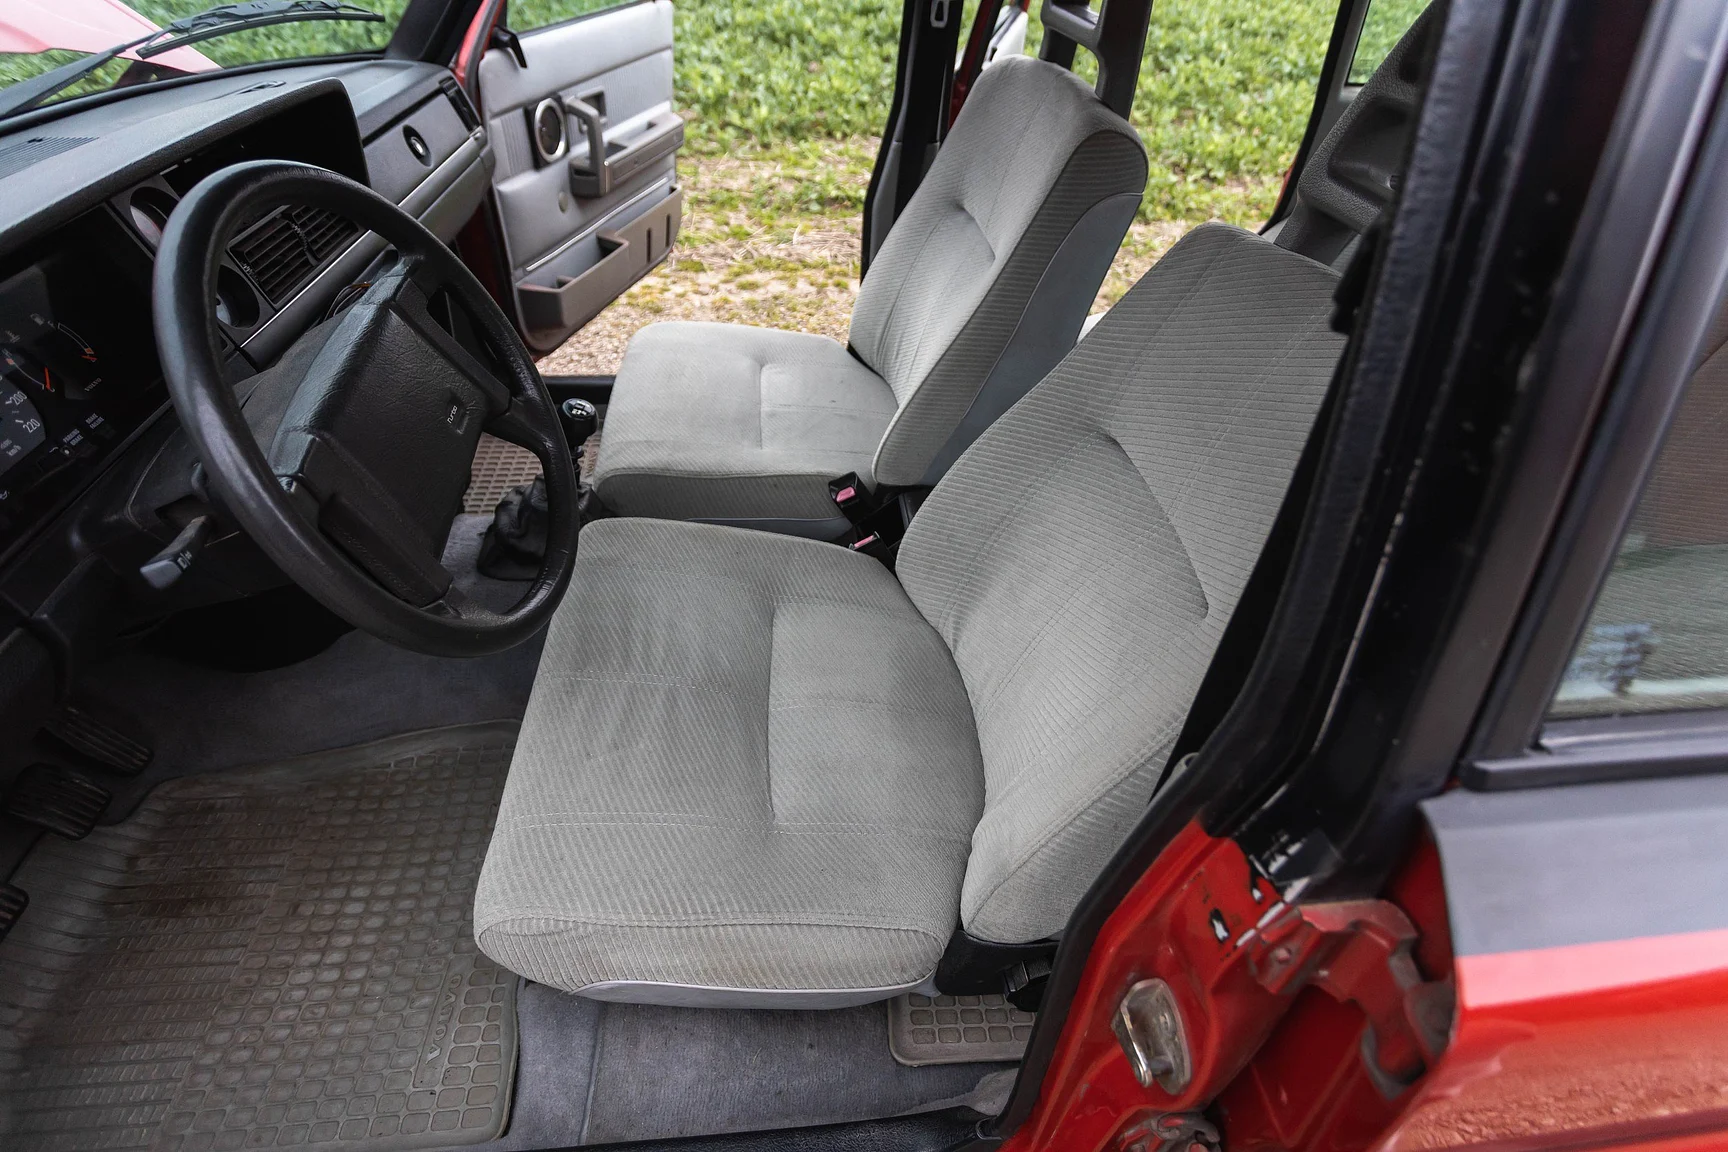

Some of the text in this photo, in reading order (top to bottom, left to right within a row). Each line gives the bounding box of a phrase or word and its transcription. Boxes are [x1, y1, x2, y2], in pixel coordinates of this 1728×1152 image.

[84, 377, 102, 391] VOLVO
[9, 391, 27, 405] 200
[22, 419, 40, 433] 220
[425, 973, 462, 1065] VOLVO
